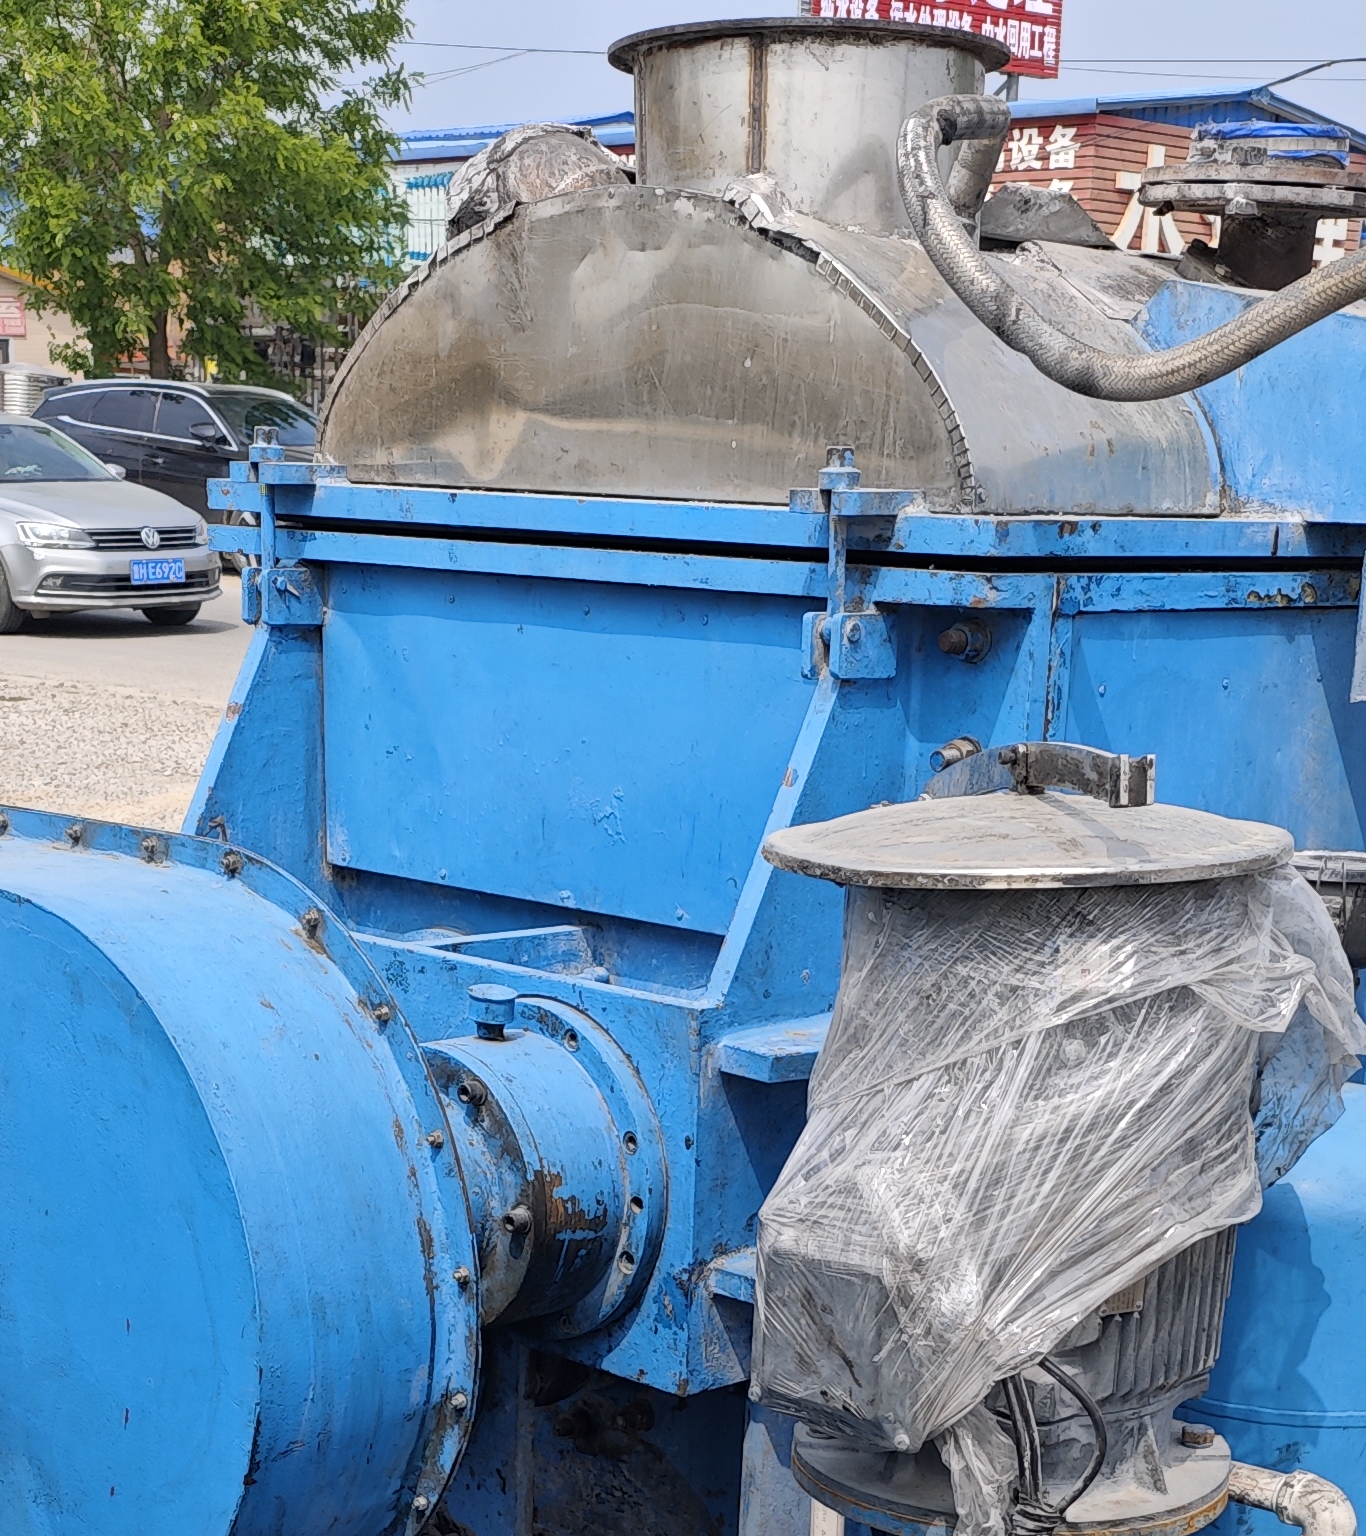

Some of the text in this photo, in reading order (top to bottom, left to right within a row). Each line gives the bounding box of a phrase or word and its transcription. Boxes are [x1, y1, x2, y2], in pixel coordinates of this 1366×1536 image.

[981, 16, 1055, 66] 中水回用工程
[995, 125, 1081, 172] 设备
